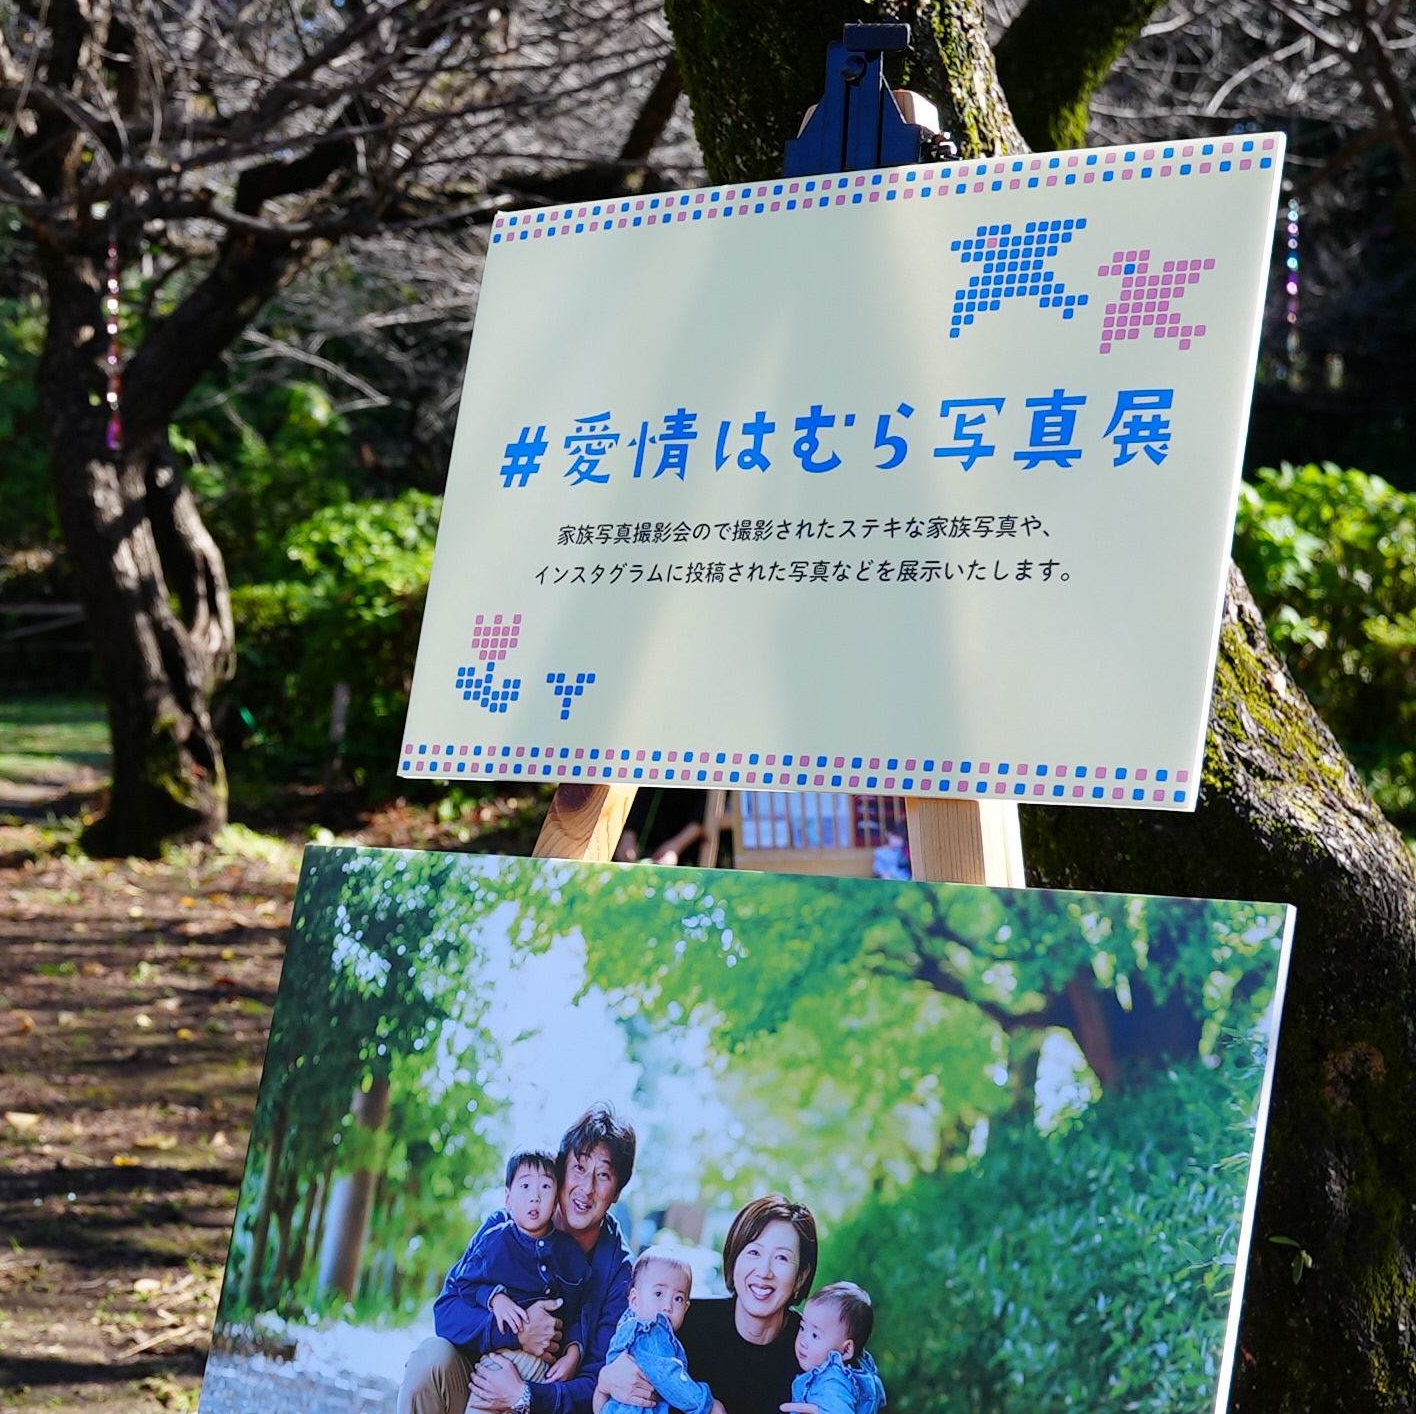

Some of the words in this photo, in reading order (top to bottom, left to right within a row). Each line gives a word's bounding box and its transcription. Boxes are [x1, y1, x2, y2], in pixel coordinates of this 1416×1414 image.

[500, 388, 1174, 488] #愛情はむら写真展
[557, 514, 1050, 545] 家族写真撮影会ので撮影されたステキな家族写真や、
[535, 558, 1070, 584] インスタグラムに投稿された写真などを展示いたします。
